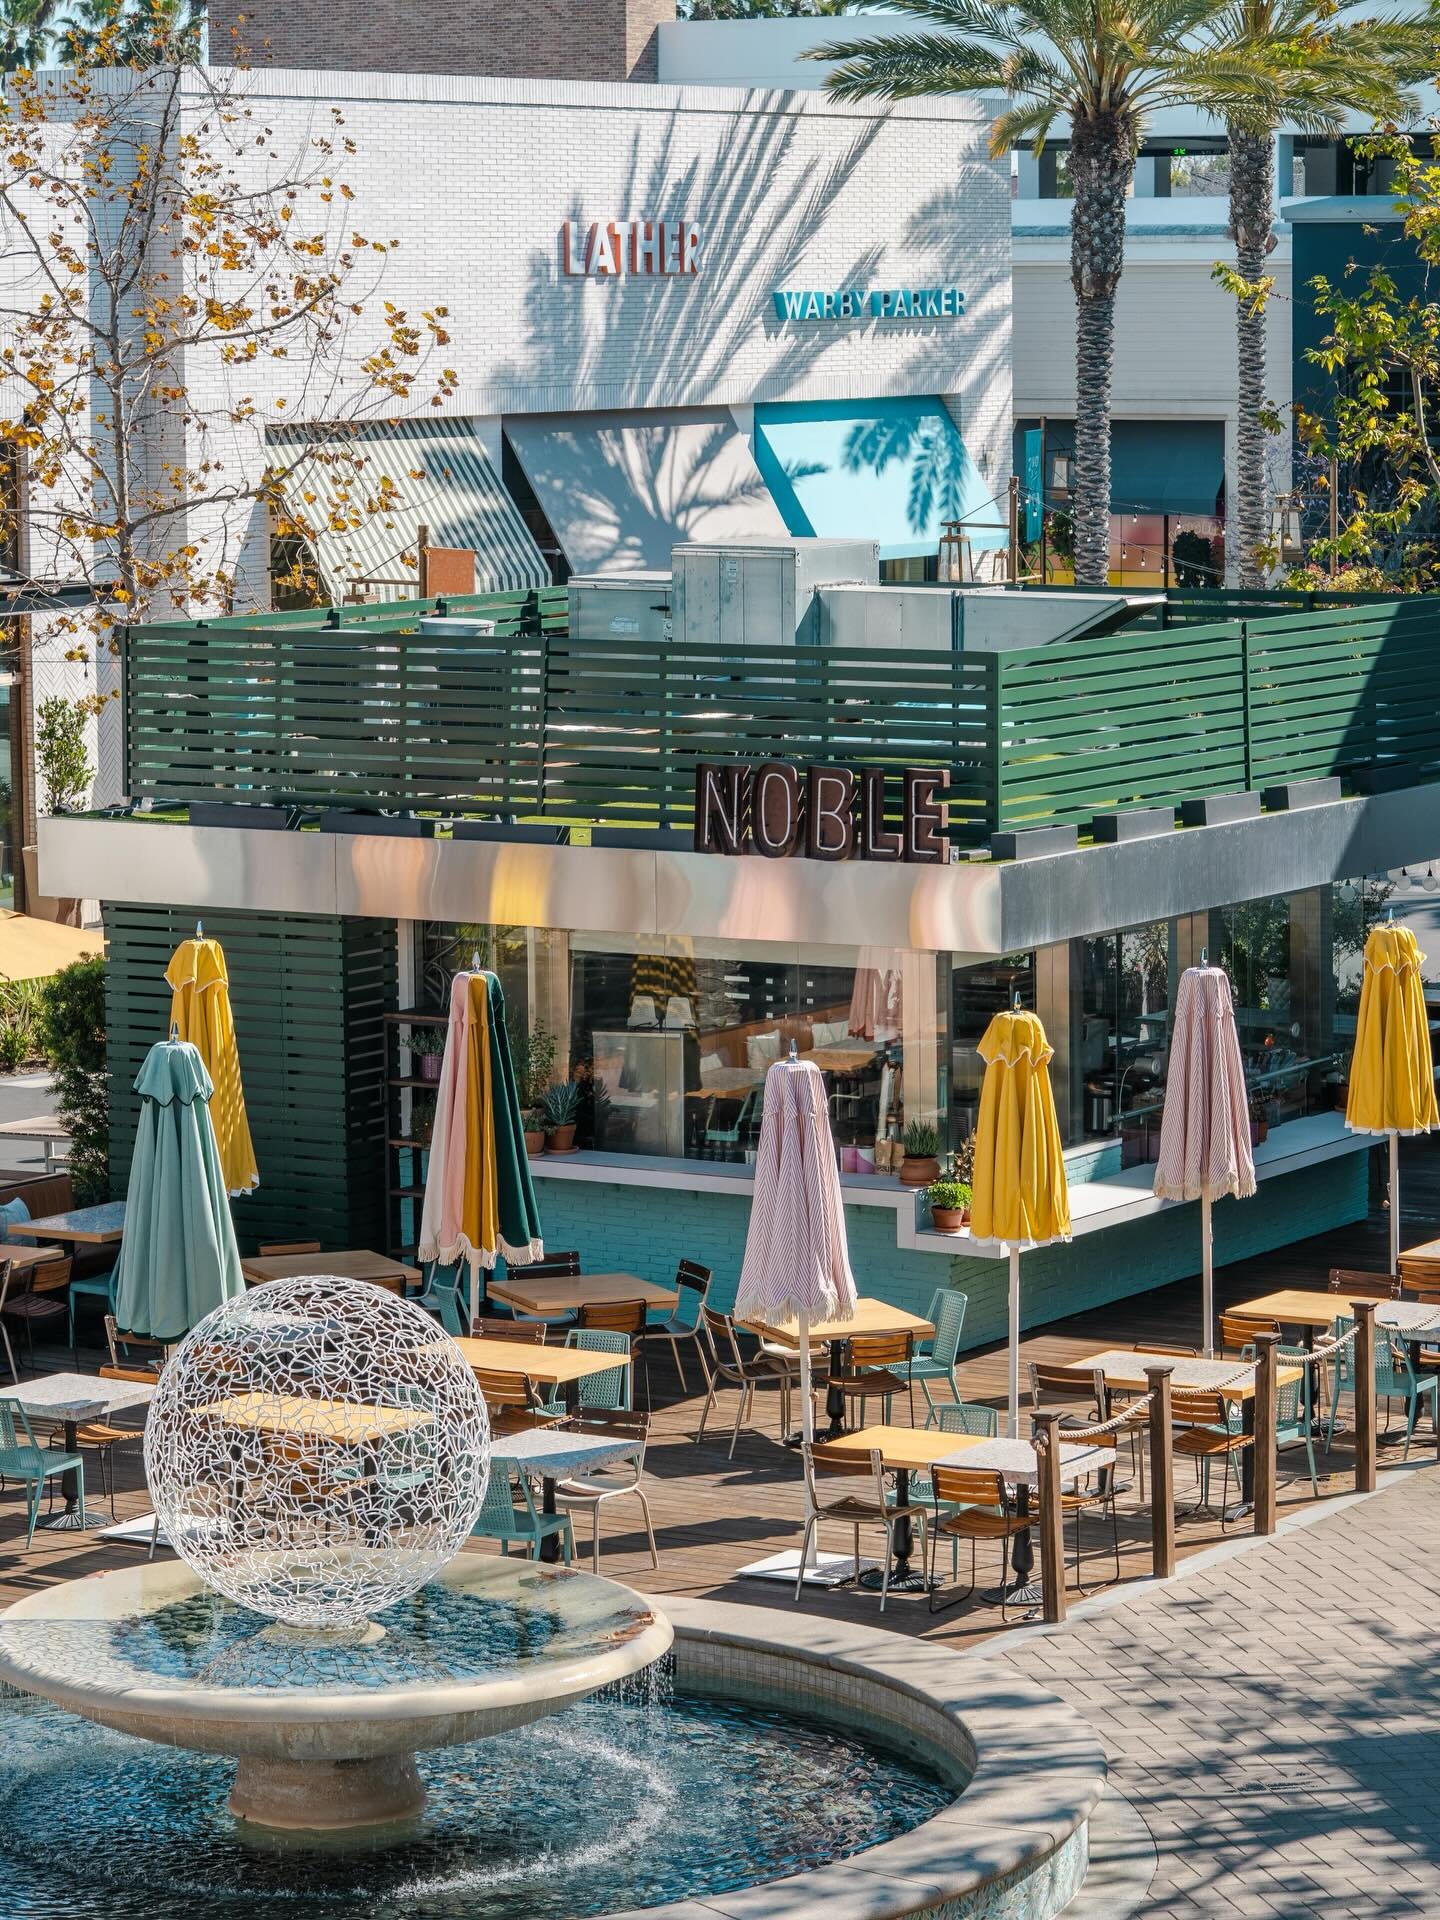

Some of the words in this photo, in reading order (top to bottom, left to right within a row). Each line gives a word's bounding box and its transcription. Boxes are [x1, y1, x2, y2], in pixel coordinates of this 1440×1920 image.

[564, 221, 704, 275] LATHER
[778, 291, 870, 320] WARBY
[874, 288, 966, 318] PARKER
[695, 762, 950, 863] NOBLE
